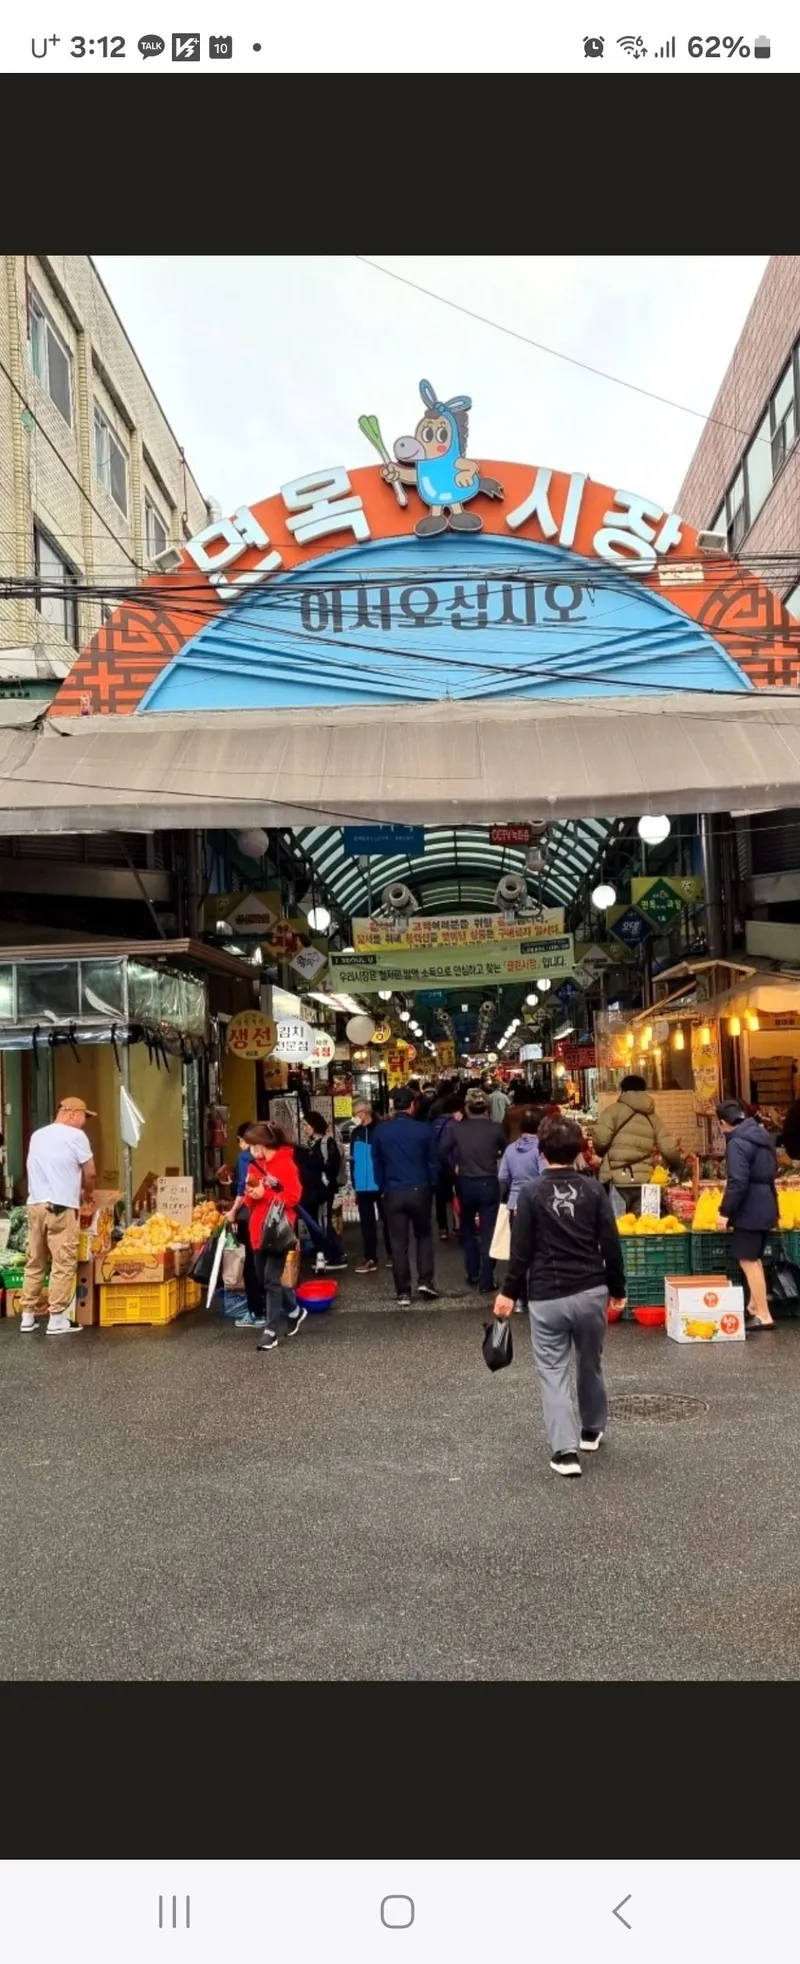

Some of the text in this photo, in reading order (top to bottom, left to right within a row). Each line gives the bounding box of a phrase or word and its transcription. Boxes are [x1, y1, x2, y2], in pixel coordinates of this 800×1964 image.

[185, 465, 682, 599] 면목 시장
[302, 581, 589, 633] 어서오십시오
[473, 917, 492, 928] 위한
[339, 969, 377, 983] 우리시장은
[403, 968, 419, 980] 방역
[421, 965, 452, 978] 소독으로
[453, 963, 484, 976] 안심하고
[486, 962, 502, 974] 찾는
[542, 955, 566, 968] 입니다.
[229, 1027, 272, 1050] 생선
[280, 1025, 304, 1038] 김치
